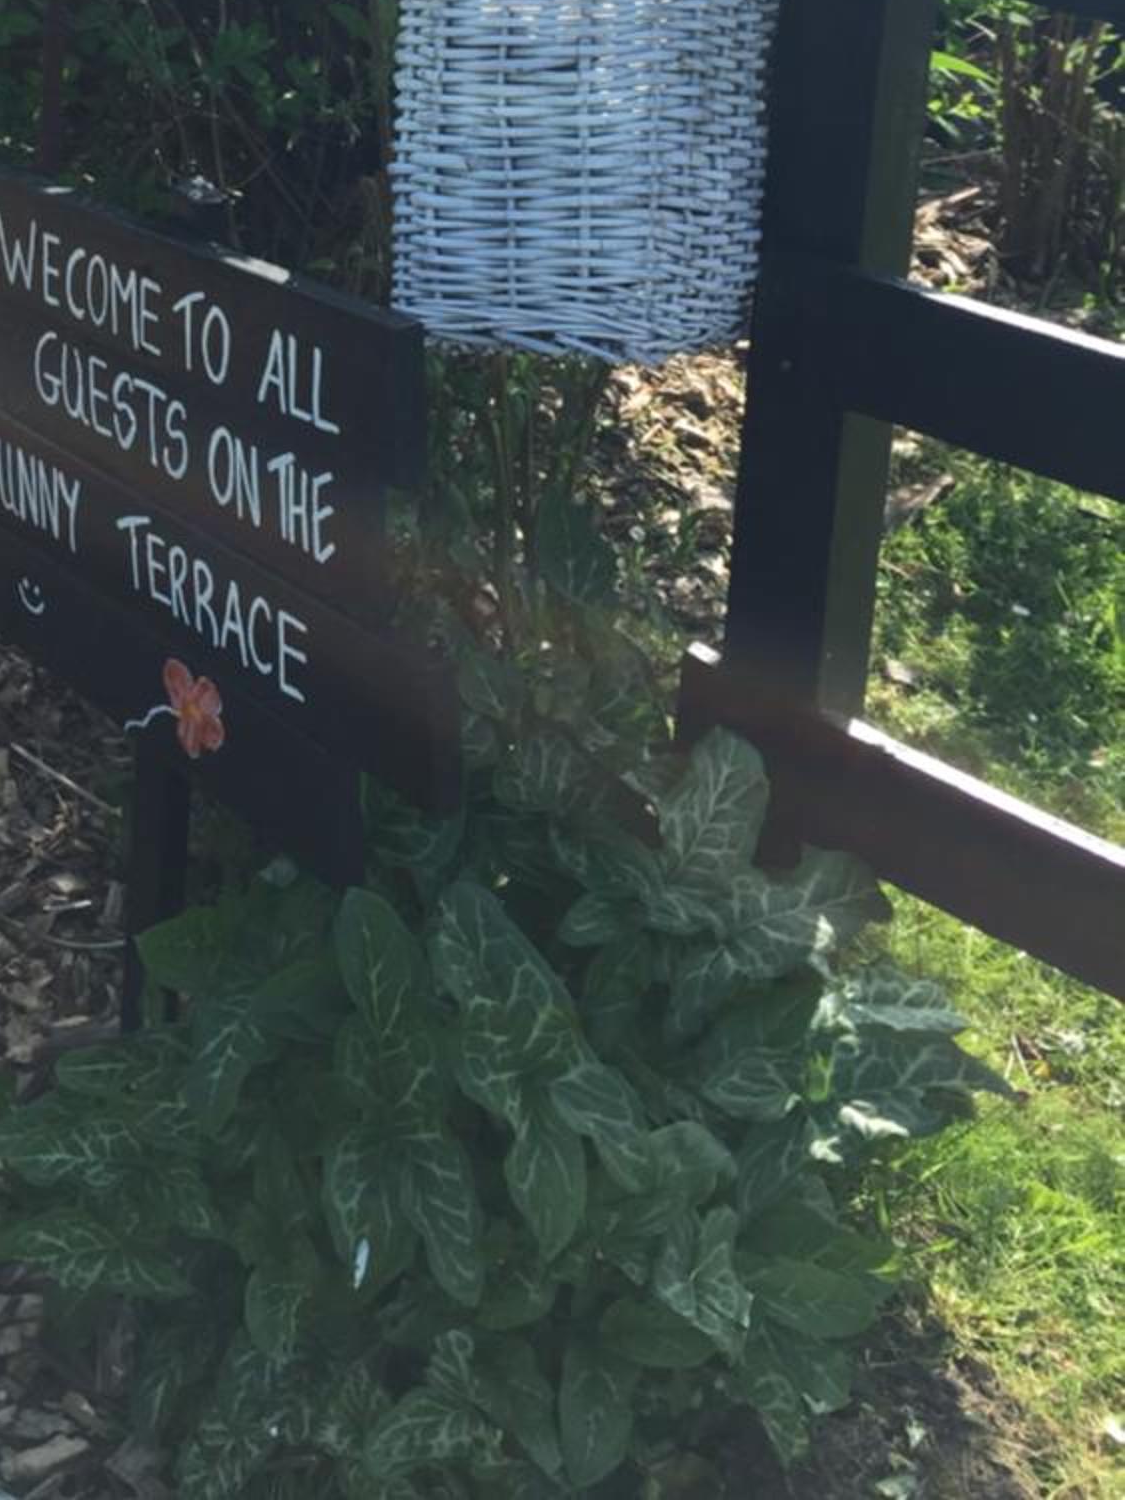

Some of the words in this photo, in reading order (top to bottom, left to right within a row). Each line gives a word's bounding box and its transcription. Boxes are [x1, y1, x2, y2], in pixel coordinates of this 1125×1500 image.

[34, 331, 188, 480] GUESTS
[207, 427, 261, 527] ON
[267, 452, 335, 562] THE
[173, 291, 231, 385] TO
[258, 328, 339, 434] ALL
[116, 515, 308, 702] TERRACE
